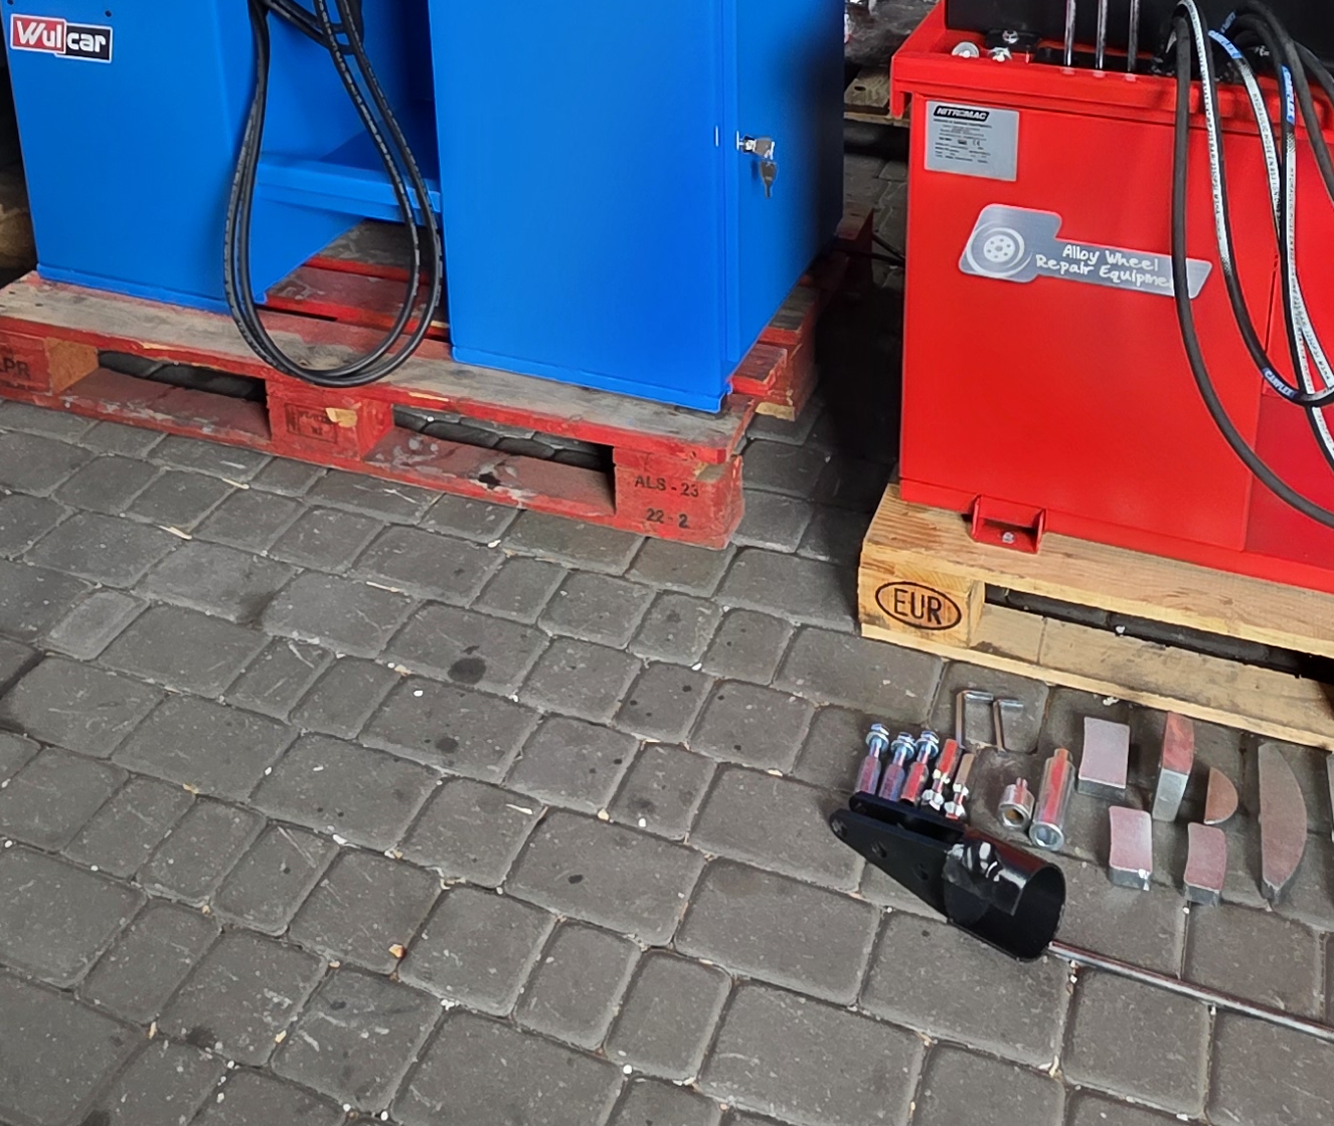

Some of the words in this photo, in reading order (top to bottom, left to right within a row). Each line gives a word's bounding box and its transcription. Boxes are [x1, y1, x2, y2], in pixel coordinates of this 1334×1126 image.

[15, 20, 107, 53] Wulcar
[936, 108, 987, 120] NITROMAC
[1251, 91, 1268, 133] HYDRAULIC
[1262, 132, 1273, 154] HOSE
[1036, 254, 1094, 276] Repair
[1062, 244, 1100, 265] Alloy
[1105, 250, 1159, 272] Wheel
[1265, 367, 1294, 397] CANFLEX
[634, 474, 666, 491] ALS
[680, 482, 699, 498] 23
[646, 507, 665, 524] 22
[678, 513, 691, 529] 2
[893, 587, 942, 625] EUR
